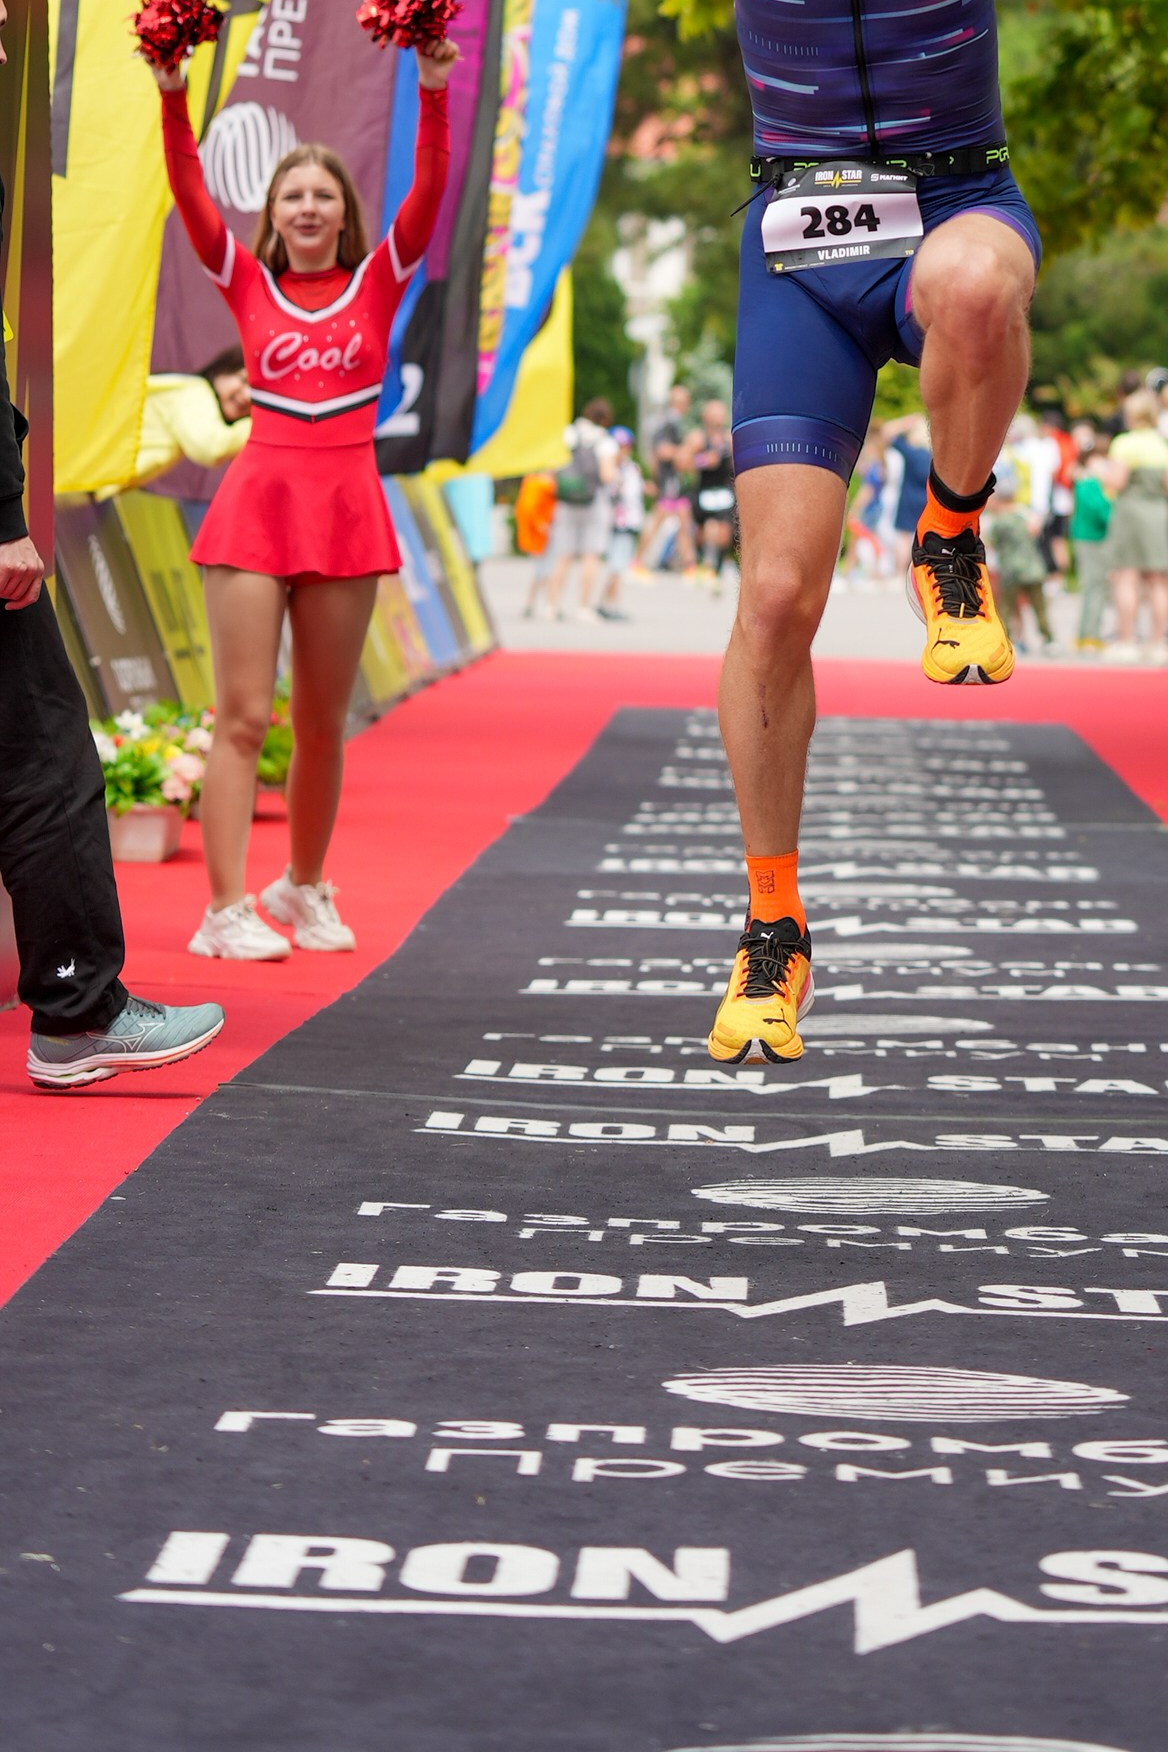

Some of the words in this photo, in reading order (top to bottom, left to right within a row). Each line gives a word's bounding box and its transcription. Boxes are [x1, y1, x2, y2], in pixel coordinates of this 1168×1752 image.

[800, 203, 881, 240] 284
[817, 245, 871, 261] VLADIMIR
[260, 331, 363, 380] Cool
[464, 1059, 765, 1085] IRON
[424, 1111, 756, 1142] IRON
[326, 1262, 749, 1300] IRON
[146, 1530, 731, 1603] IRON
